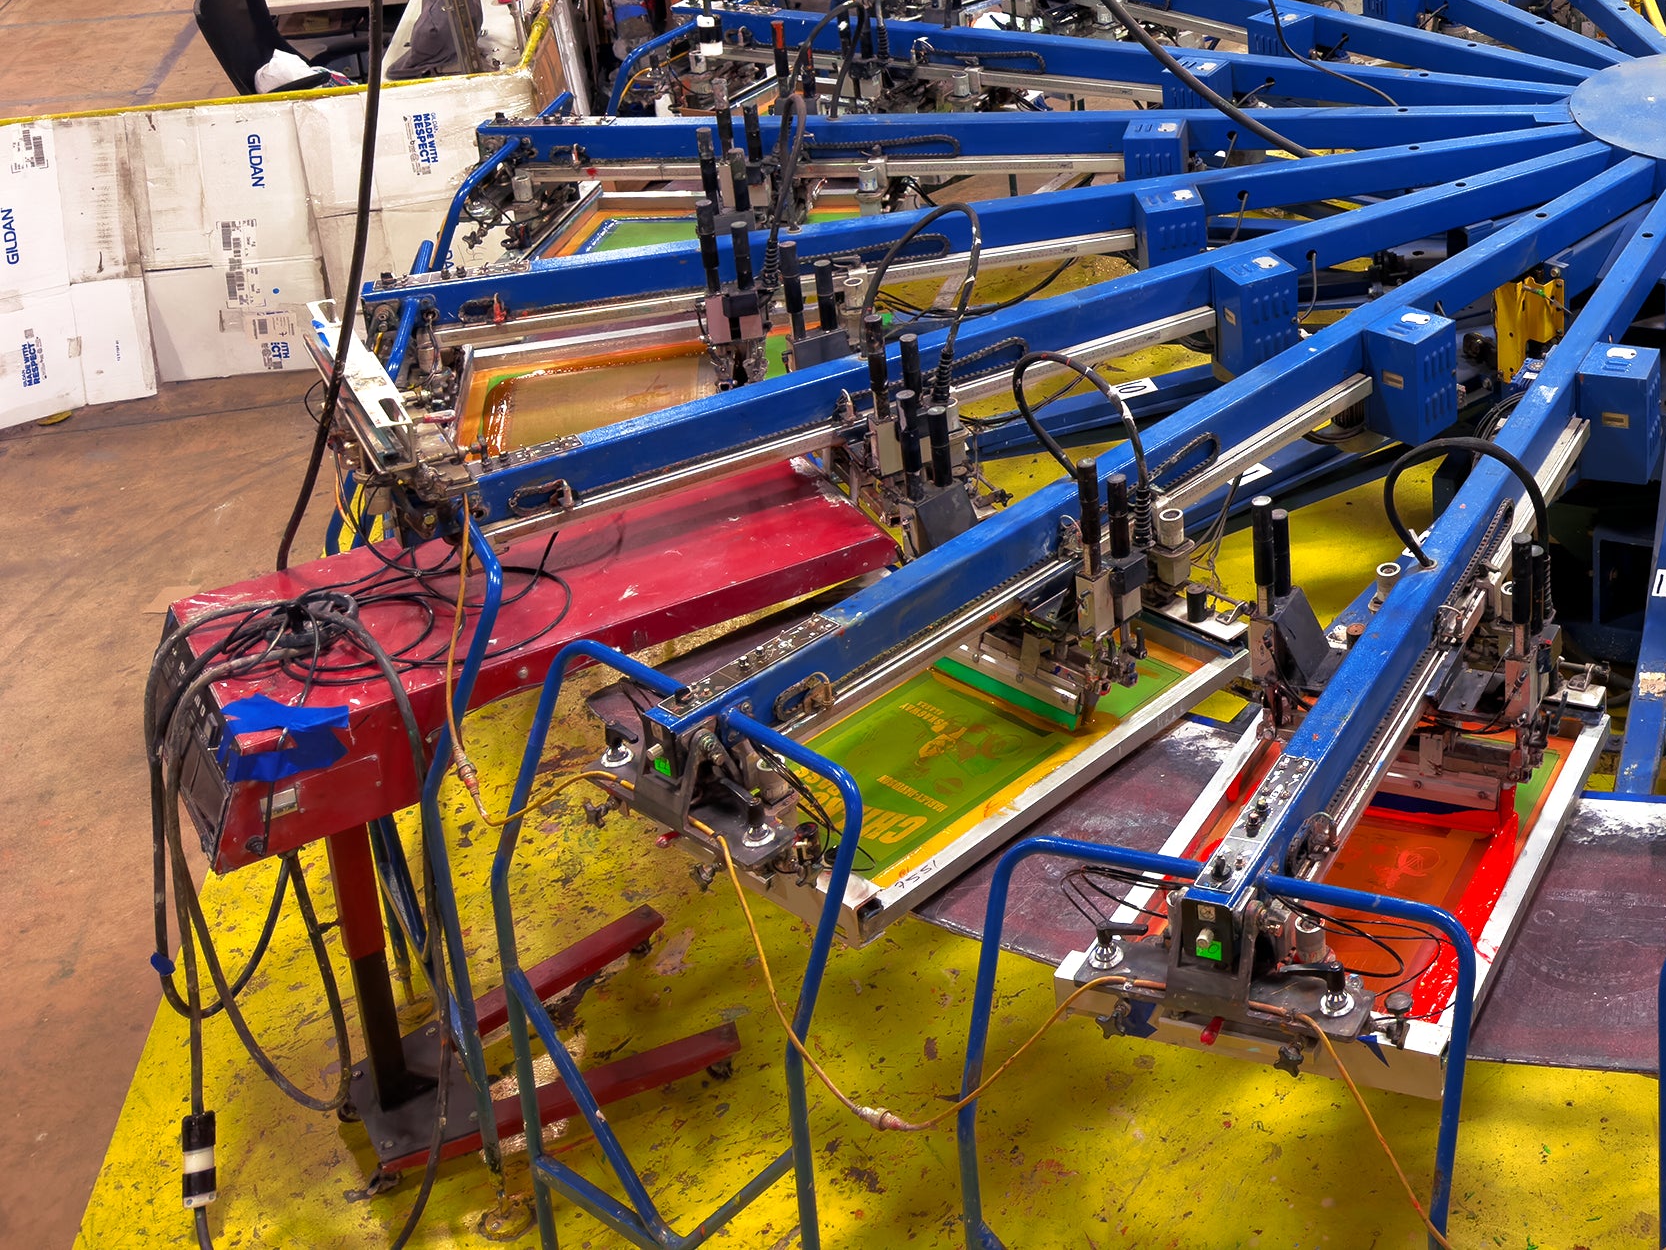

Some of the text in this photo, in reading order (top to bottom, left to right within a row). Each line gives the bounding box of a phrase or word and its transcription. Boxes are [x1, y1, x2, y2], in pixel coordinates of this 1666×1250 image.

[247, 133, 265, 188] GILDAN
[412, 114, 431, 164] RESPECT
[422, 113, 439, 163] MADE WITH
[0, 206, 20, 265] GILDAN
[21, 343, 34, 387] MADE WITH
[28, 342, 41, 385] RESPECT
[876, 774, 949, 813] HARLEY-DAVIDSON
